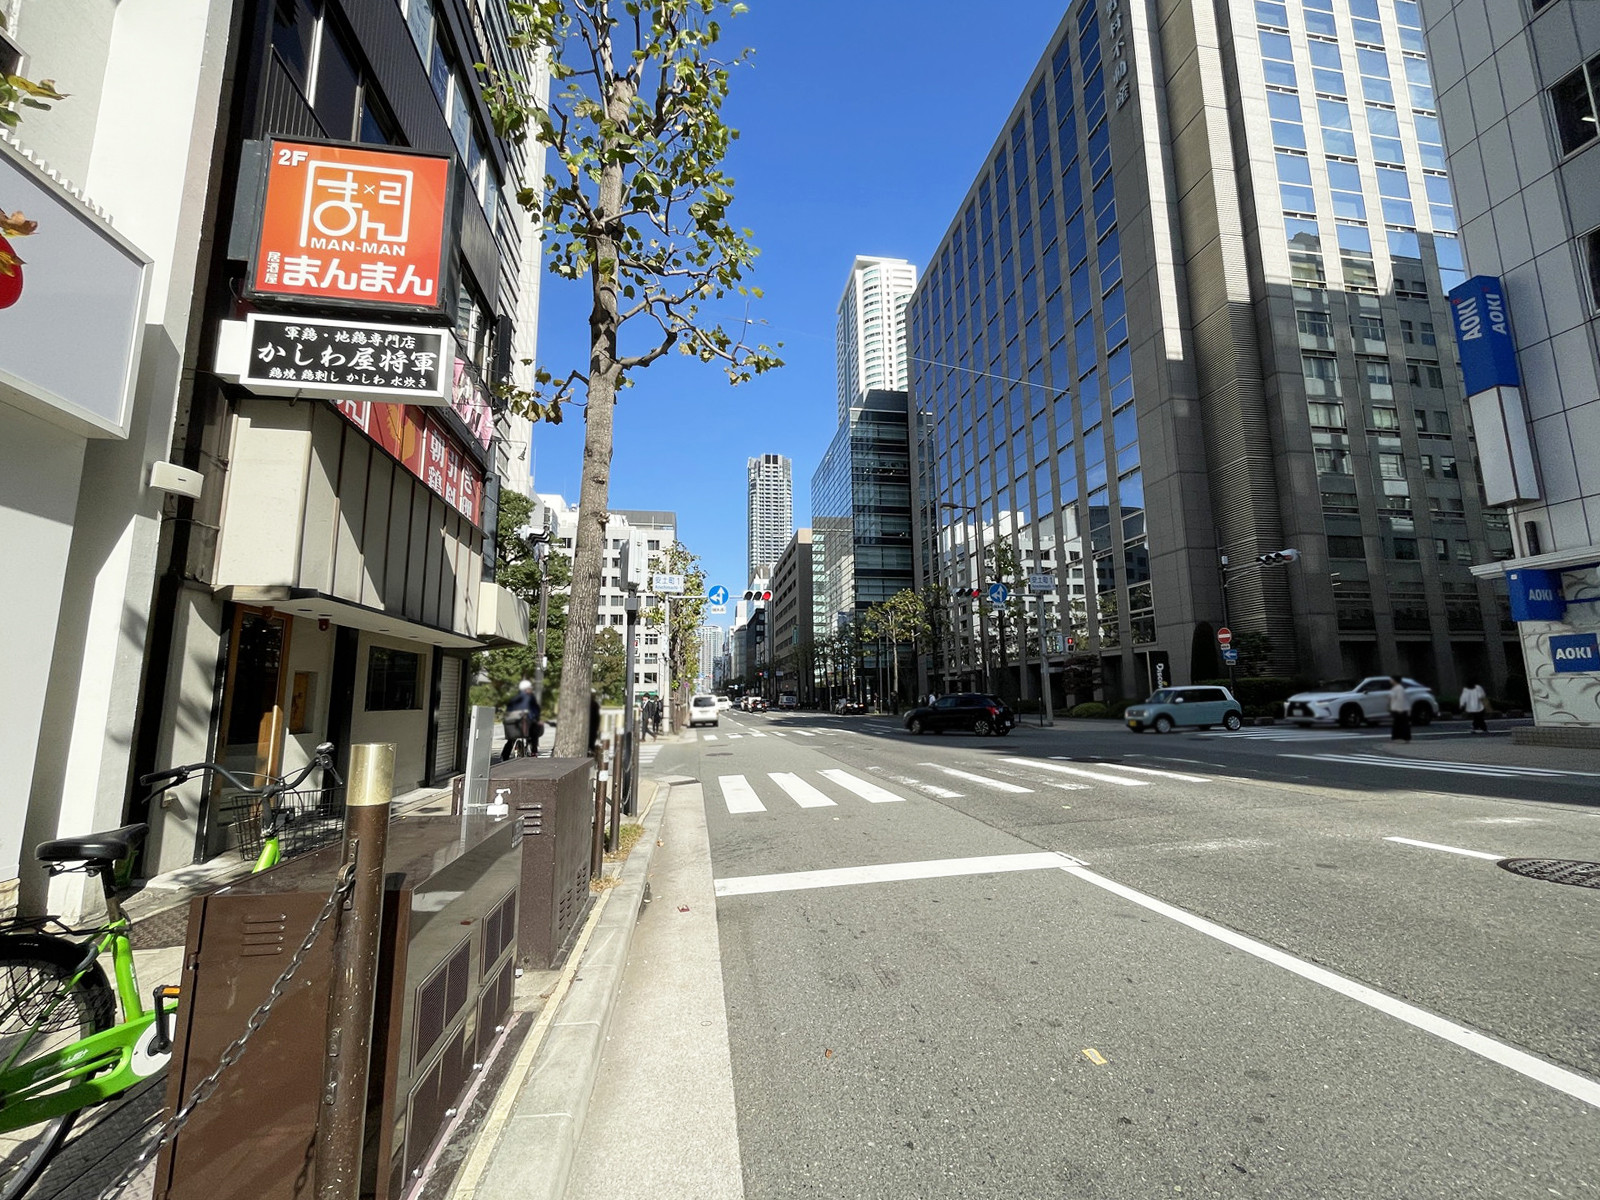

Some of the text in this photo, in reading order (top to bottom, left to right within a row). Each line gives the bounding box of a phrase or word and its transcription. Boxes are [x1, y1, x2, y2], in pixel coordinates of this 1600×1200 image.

[278, 149, 308, 166] 2F
[310, 237, 406, 257] MAN-MAN
[264, 251, 281, 285] 居酒屋
[282, 255, 433, 297] まんまん
[1457, 297, 1482, 341] AOKI
[1486, 293, 1507, 335] AOKI
[284, 325, 416, 349] 軍鶏・地鶏専門店
[257, 341, 438, 376] かしわ屋将軍
[346, 372, 386, 385] かしわ
[390, 375, 427, 389] 水炊き
[1528, 588, 1553, 601] AOKI
[1555, 646, 1593, 660] AOKI
